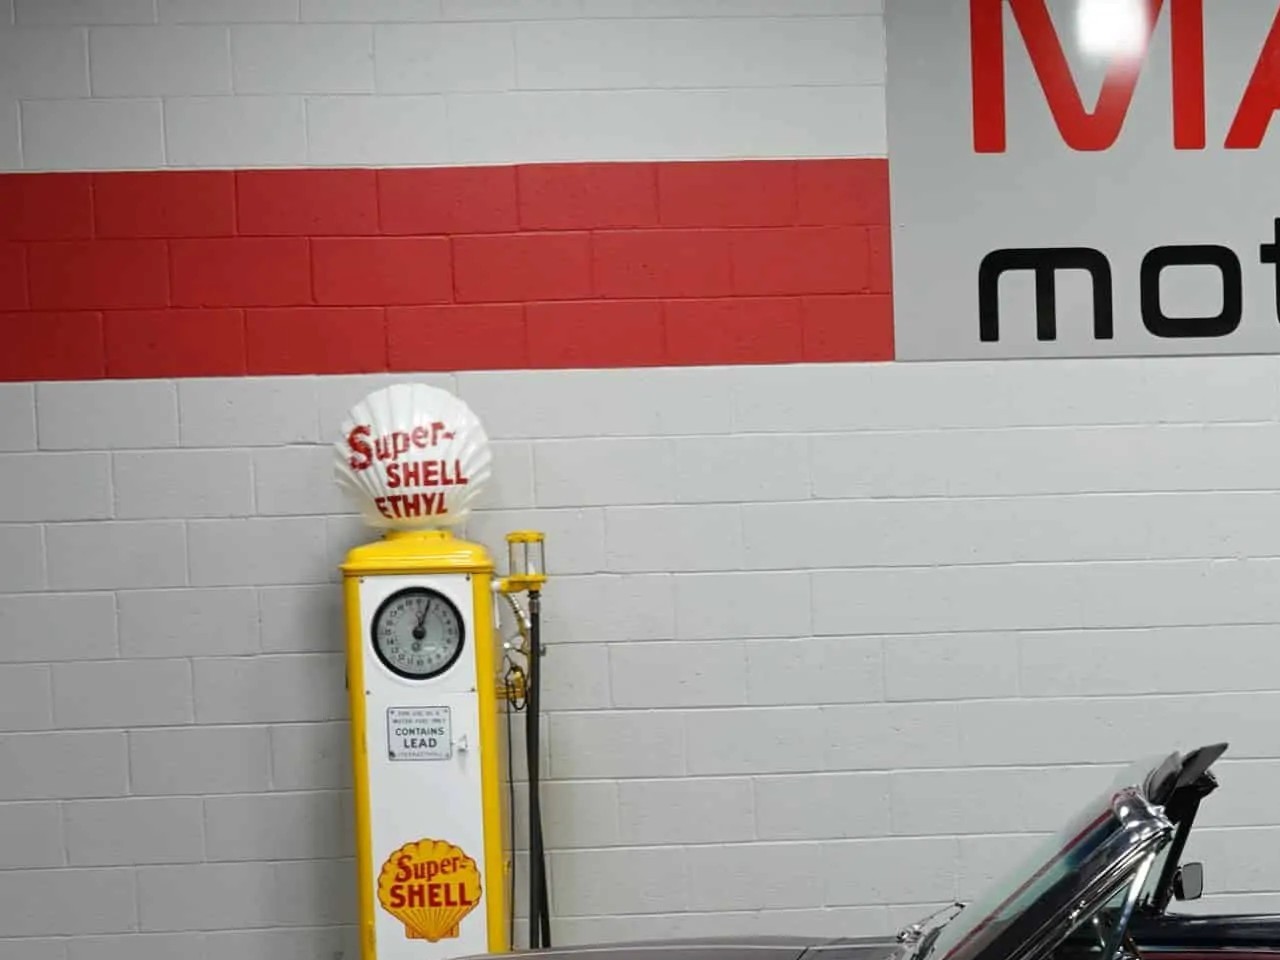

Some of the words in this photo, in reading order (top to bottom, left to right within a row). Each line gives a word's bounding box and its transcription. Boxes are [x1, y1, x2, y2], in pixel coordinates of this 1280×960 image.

[346, 421, 456, 473] Super-
[386, 459, 469, 489] SHELL
[374, 493, 448, 519] ETHYL
[395, 727, 446, 736] CONTAINS
[403, 738, 438, 748] LEAD
[394, 854, 468, 883] Super-
[389, 882, 473, 909] SHELL
